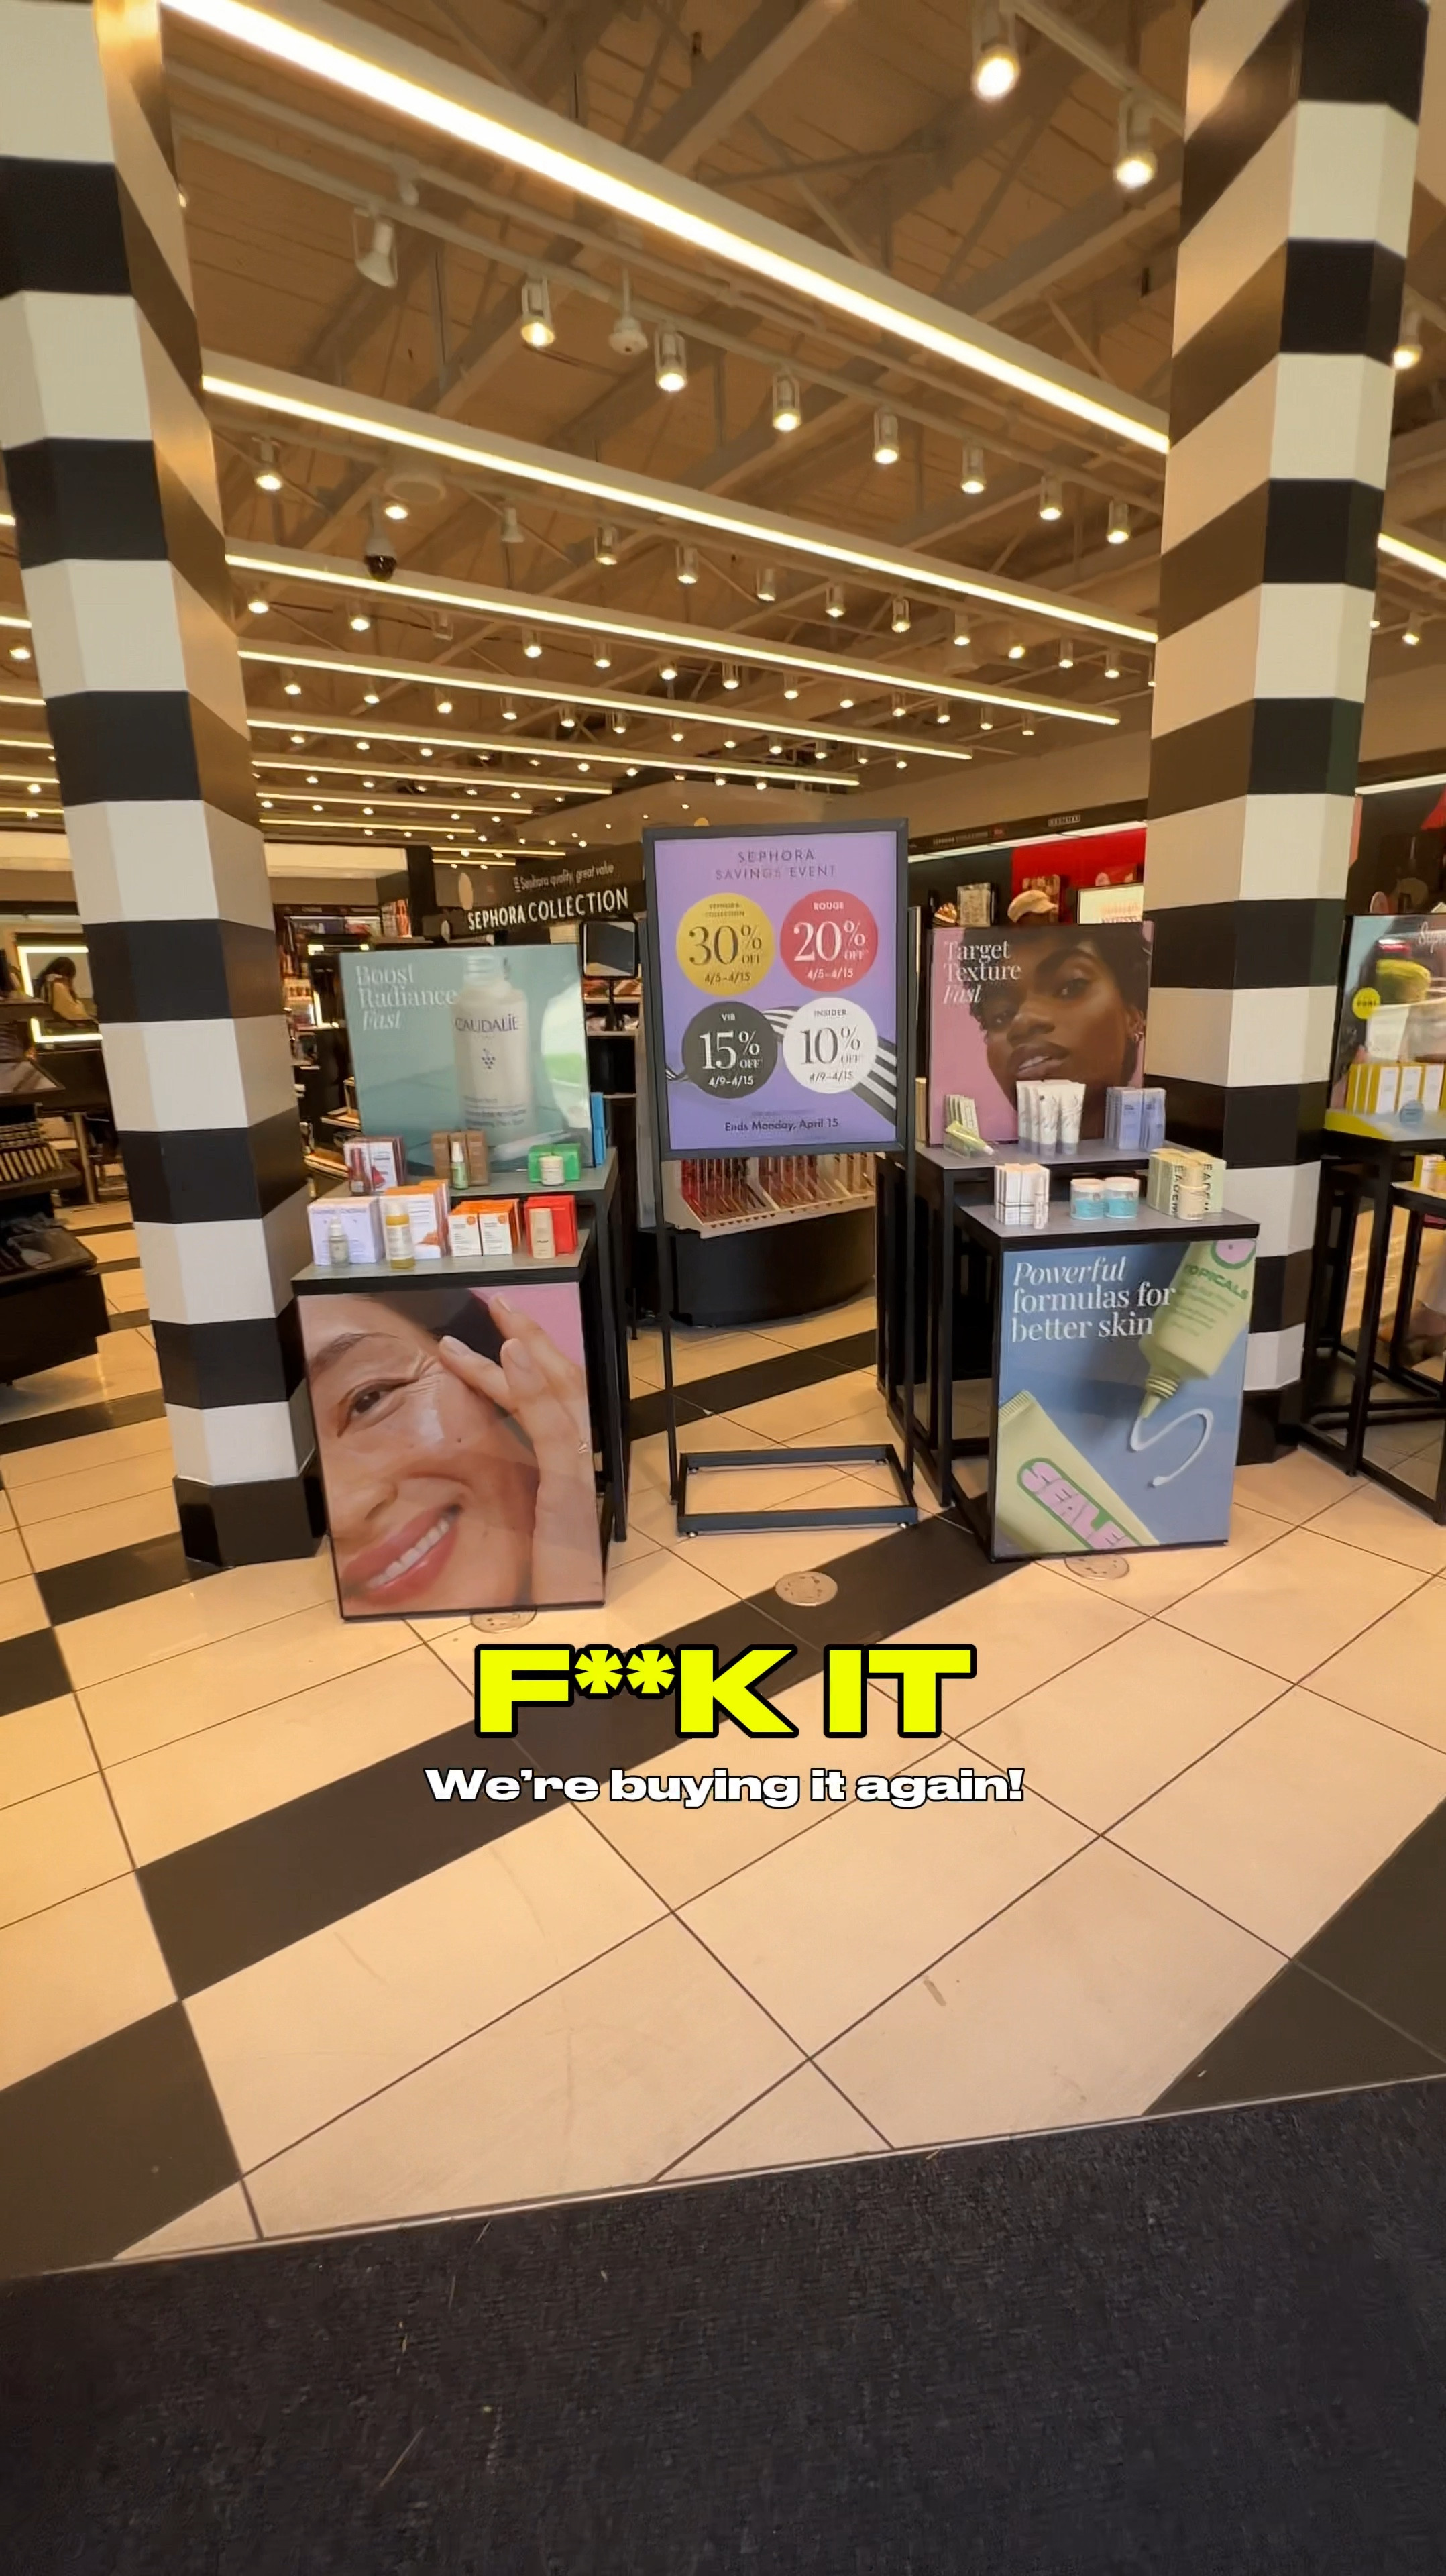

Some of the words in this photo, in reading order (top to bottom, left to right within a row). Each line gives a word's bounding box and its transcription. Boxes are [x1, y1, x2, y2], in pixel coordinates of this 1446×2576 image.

[738, 849, 815, 863] SEPHORA
[596, 860, 614, 875] value
[716, 868, 781, 881] SAVINGS
[789, 865, 835, 878] EVENT
[467, 904, 526, 931] SEPHORA
[528, 887, 628, 922] COLLECTION
[813, 901, 844, 910] ROUGE
[689, 924, 762, 966] 30%
[793, 920, 865, 961] 20%
[944, 940, 1011, 964] Target
[355, 963, 414, 985] Boost
[943, 963, 1022, 982] Texture
[359, 985, 459, 1008] Radiance
[943, 984, 982, 1004] Fast
[363, 1010, 401, 1031] Fast
[721, 1013, 736, 1021] VIB
[814, 1008, 847, 1018] INSIDER
[698, 1030, 760, 1069] 15%
[800, 1025, 860, 1064] 10%
[724, 1122, 748, 1132] Ends
[751, 1120, 797, 1132] Monday,
[799, 1118, 824, 1130] April
[1013, 1256, 1127, 1286] Powerful
[1184, 1264, 1249, 1300] TOPICALS
[1013, 1284, 1129, 1313] formulas
[1137, 1281, 1176, 1307] for
[1011, 1316, 1093, 1342] better
[1098, 1311, 1153, 1338] skin
